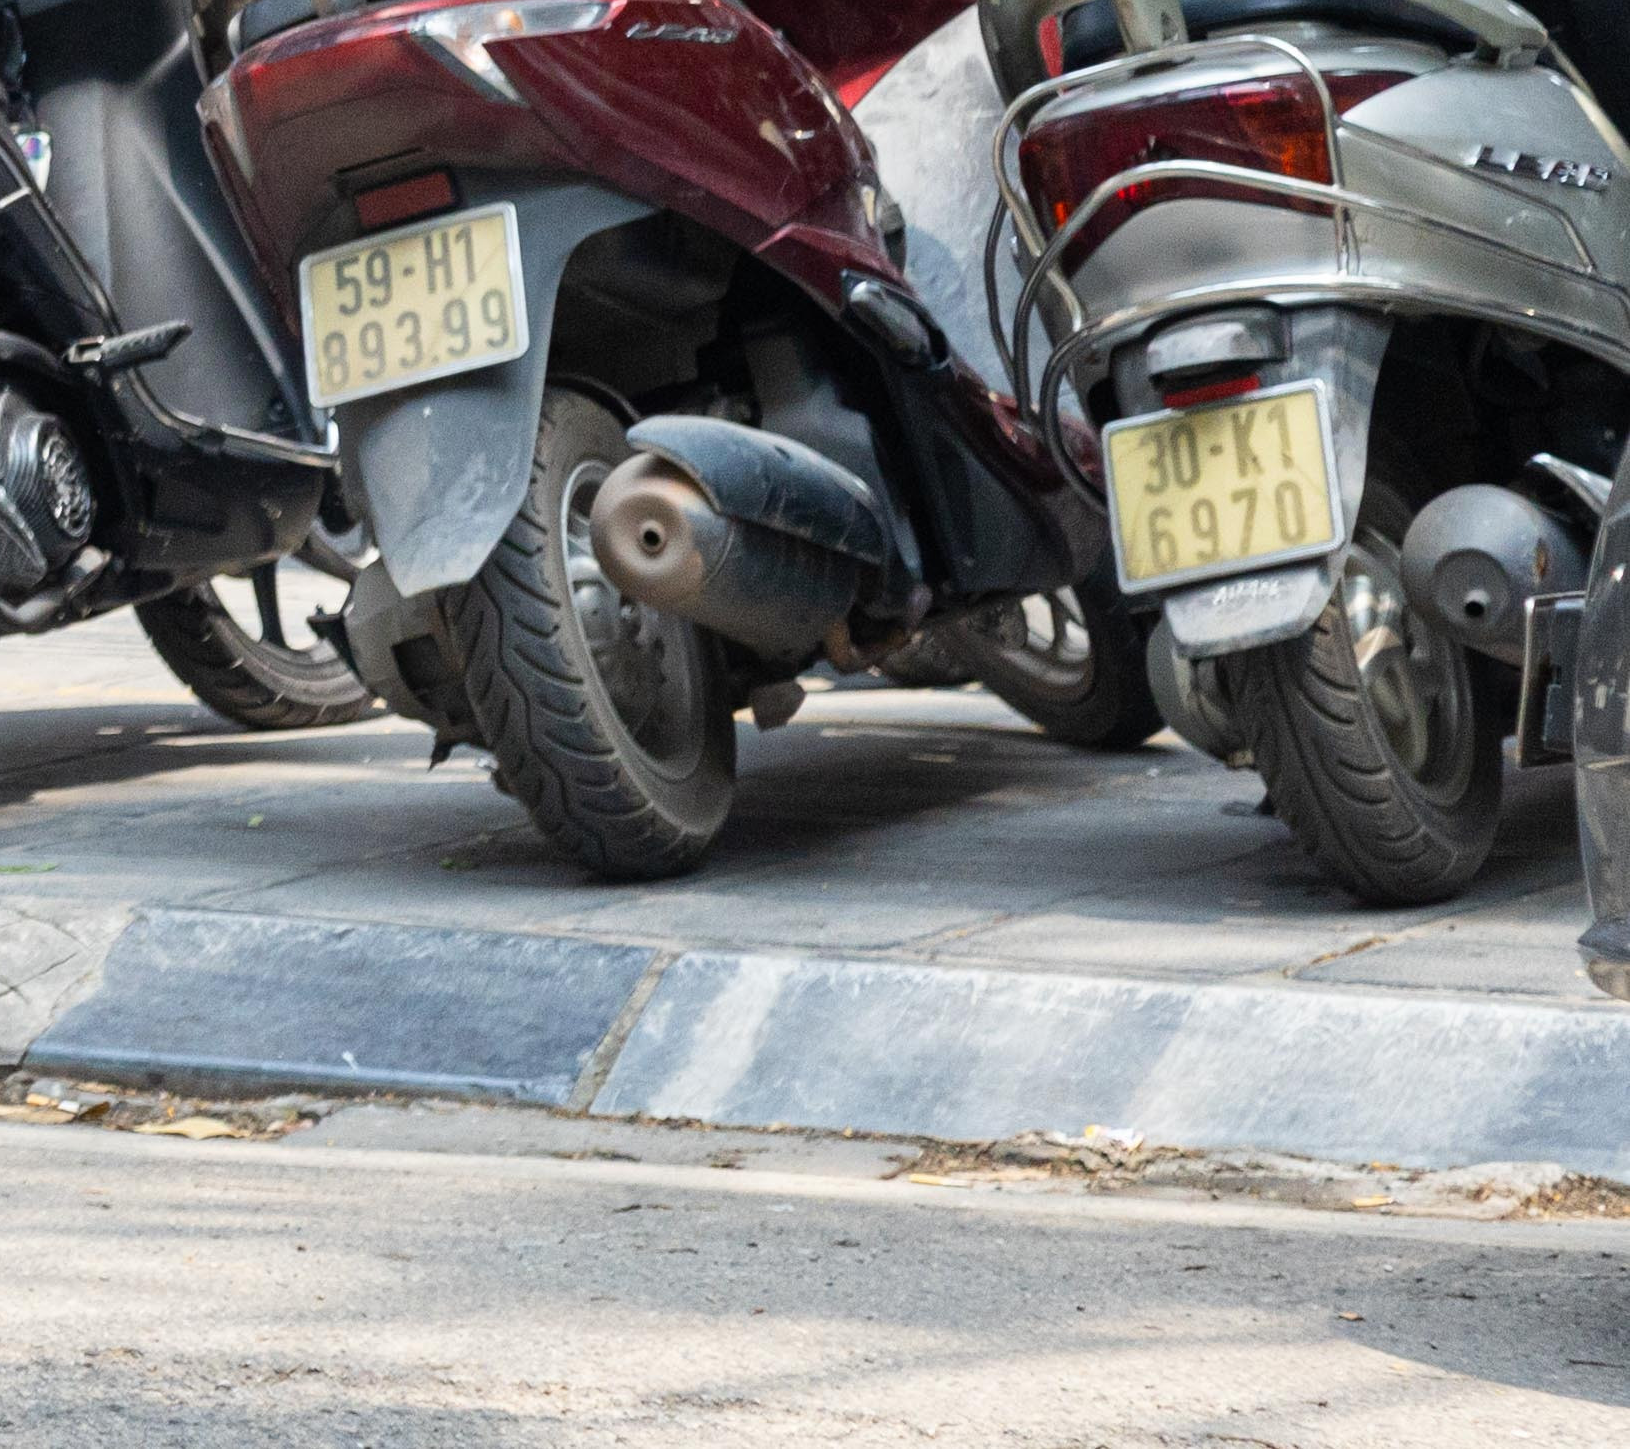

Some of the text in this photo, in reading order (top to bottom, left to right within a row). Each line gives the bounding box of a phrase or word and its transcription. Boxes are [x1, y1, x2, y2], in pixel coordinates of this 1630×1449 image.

[624, 21, 739, 45] LEAD
[1469, 143, 1611, 193] LEAD
[333, 223, 480, 317] 59-H1
[321, 287, 512, 393] 893.99
[1146, 479, 1308, 574] 6970
